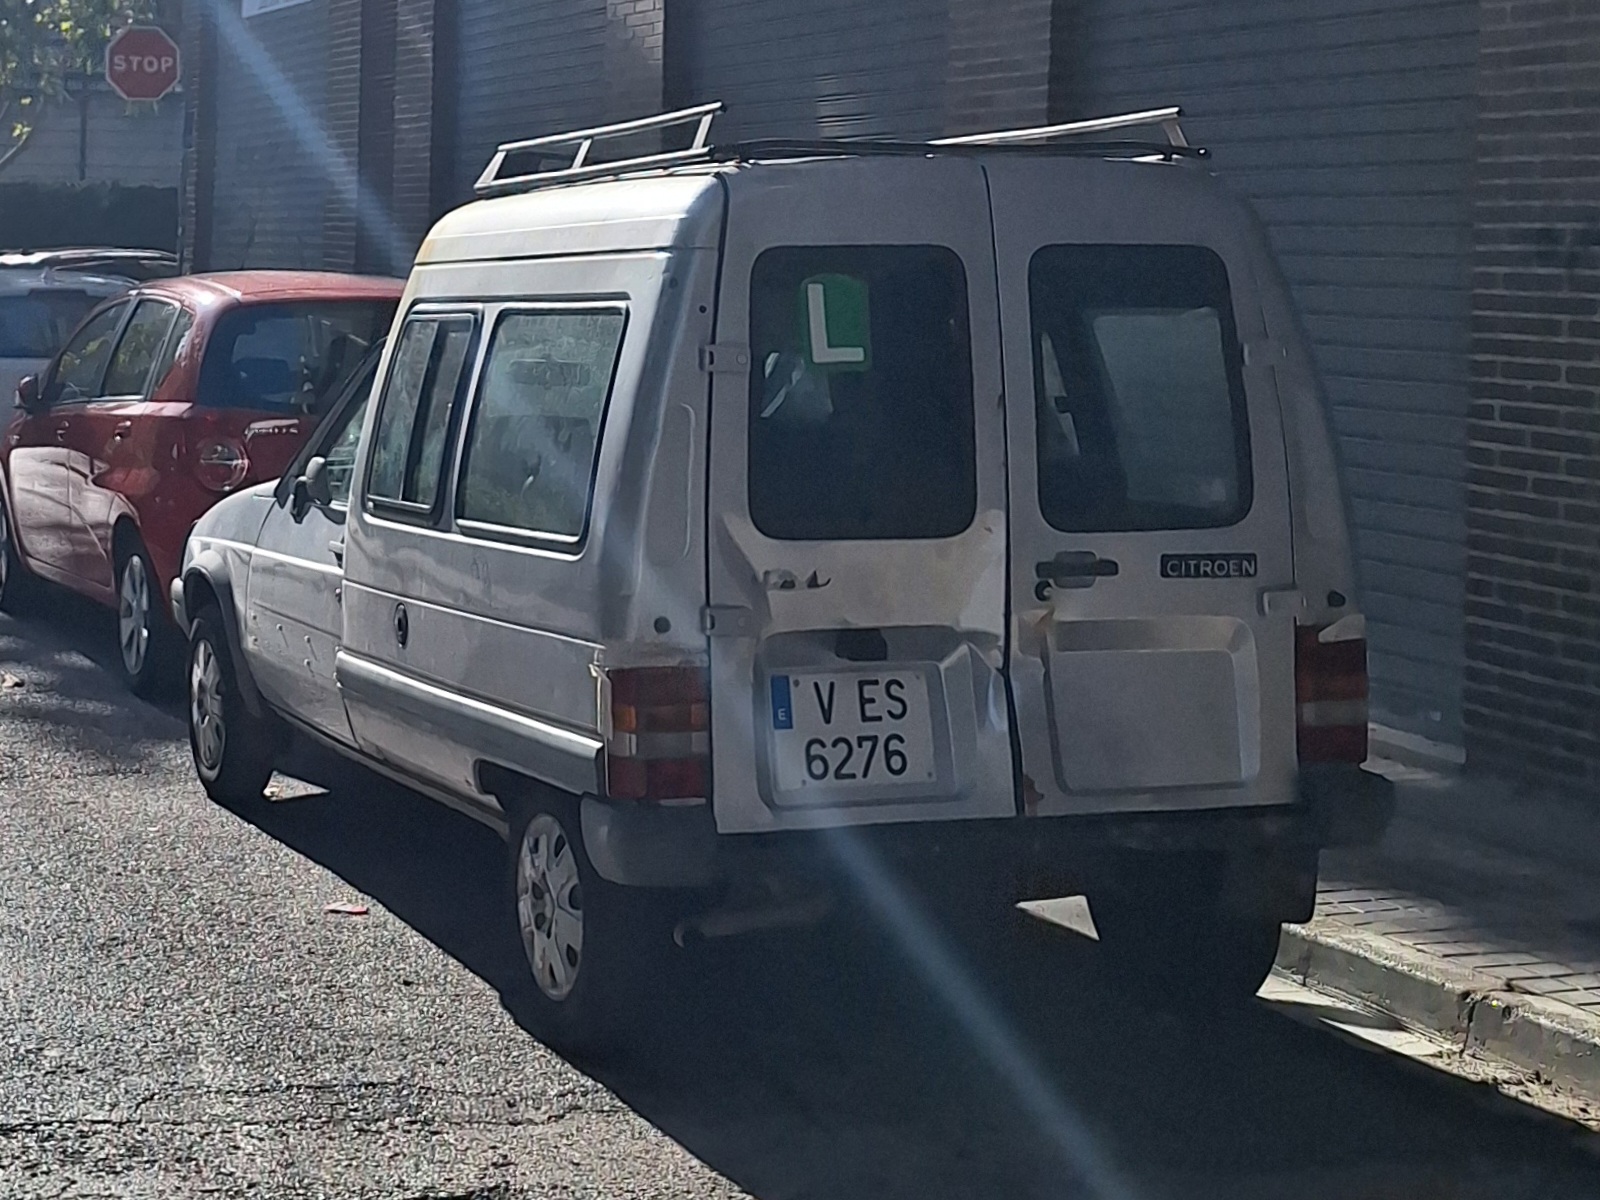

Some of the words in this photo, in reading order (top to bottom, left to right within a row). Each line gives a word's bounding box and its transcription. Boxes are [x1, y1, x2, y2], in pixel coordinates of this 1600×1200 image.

[113, 55, 174, 73] STOP
[807, 283, 865, 363] L
[1166, 559, 1255, 576] CITROEN
[777, 707, 787, 721] E
[813, 681, 835, 725] V
[857, 678, 908, 723] ES
[805, 733, 908, 780] 6276
